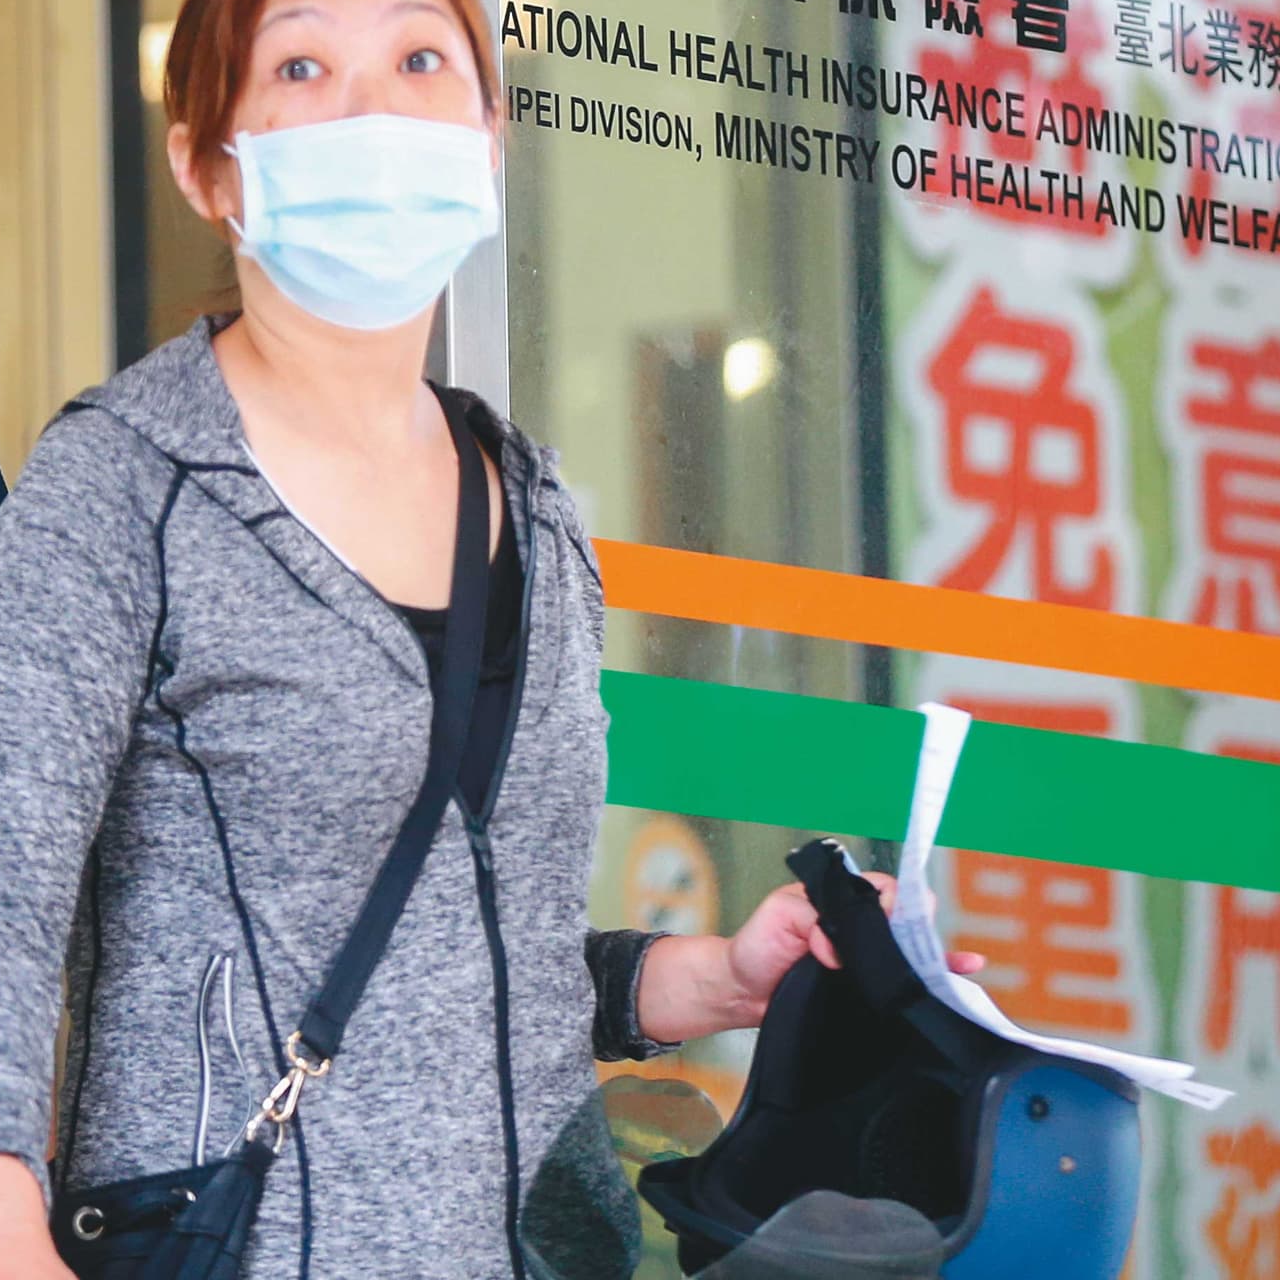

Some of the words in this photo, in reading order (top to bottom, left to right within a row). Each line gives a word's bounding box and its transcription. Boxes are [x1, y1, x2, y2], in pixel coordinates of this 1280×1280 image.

[670, 30, 808, 98] HEALTH
[822, 58, 1025, 137] INSURANCE
[570, 97, 702, 162] DIVISION,
[716, 113, 880, 183] MINISTRY
[892, 144, 938, 193] OF
[951, 156, 1084, 220] HEALTH
[1095, 181, 1165, 233] AND
